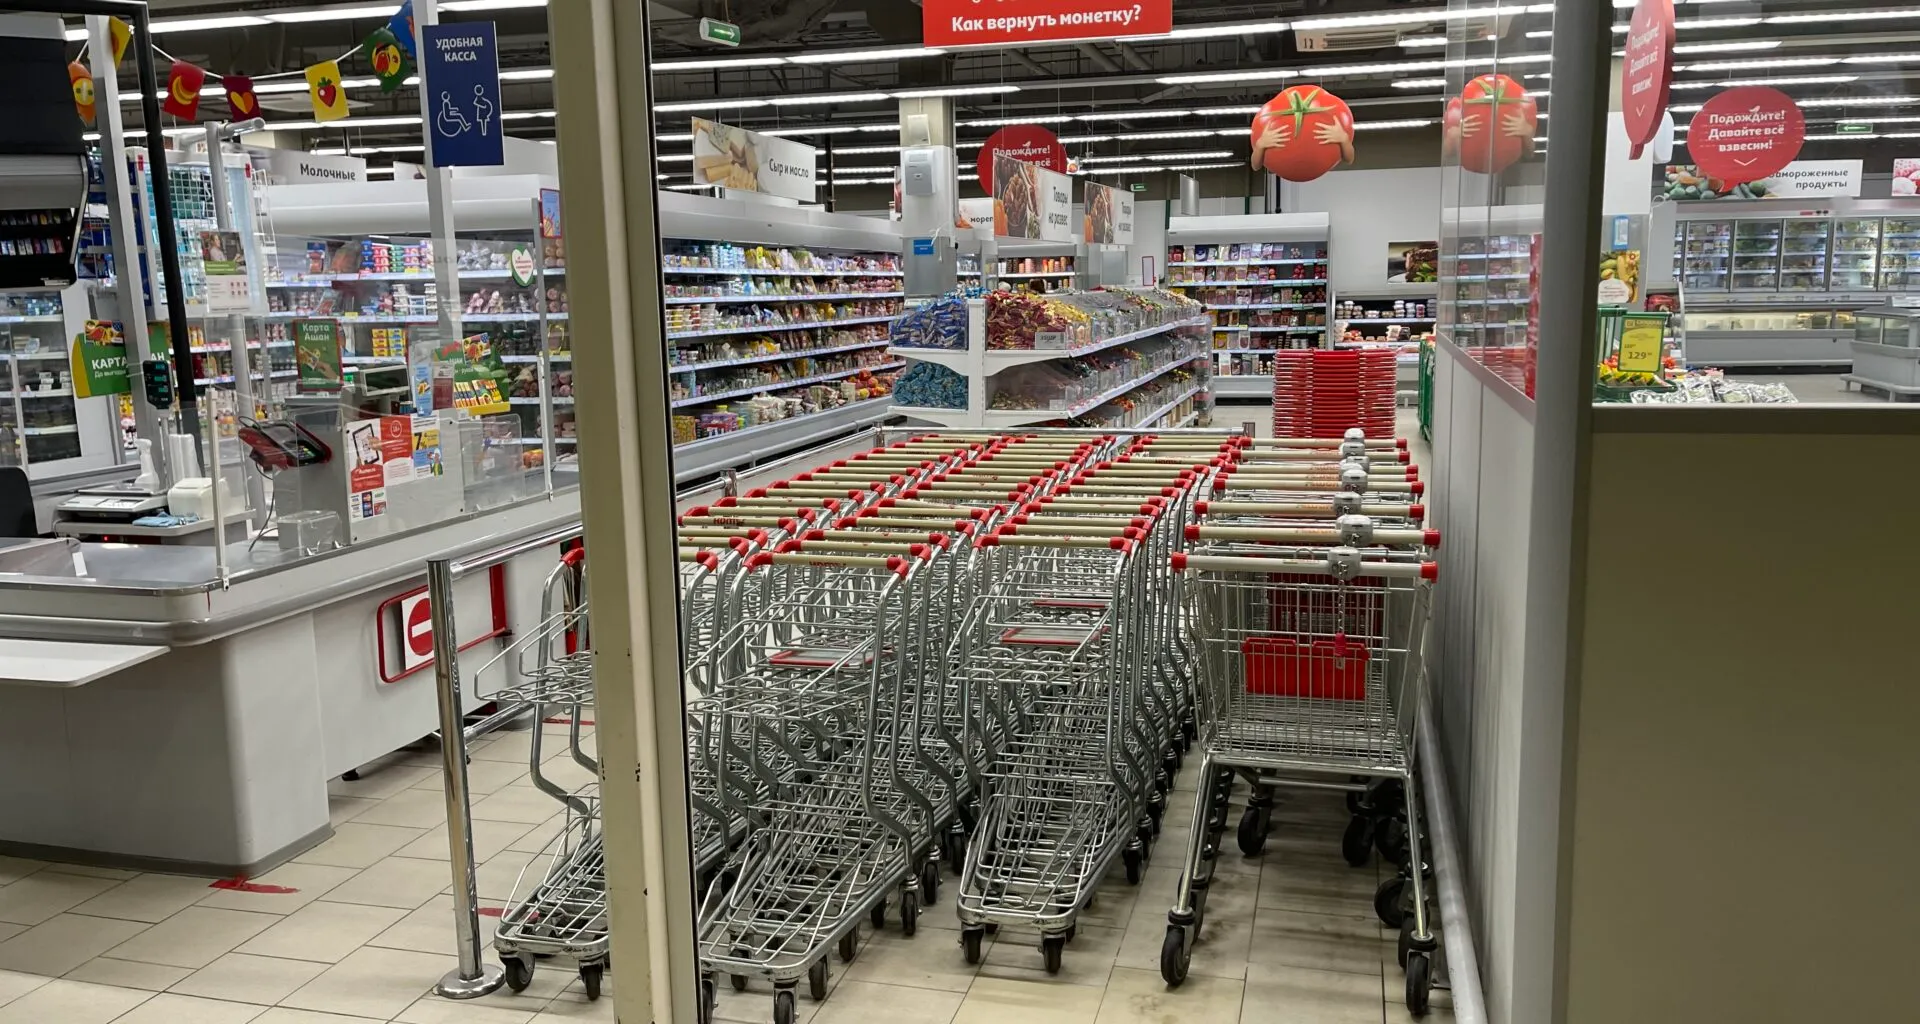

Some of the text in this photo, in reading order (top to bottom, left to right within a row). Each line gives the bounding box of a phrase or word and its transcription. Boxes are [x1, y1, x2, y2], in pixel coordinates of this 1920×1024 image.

[952, 4, 1142, 33] Как вернуть монетку?
[435, 36, 483, 51] УДОБНАЯ
[444, 51, 477, 62] КАССА
[1709, 109, 1785, 125] Подождите!
[1708, 124, 1785, 141] Давайте всё
[1718, 139, 1773, 152] взвесим!
[300, 163, 356, 180] Молочные
[769, 157, 783, 177] Сыр
[790, 165, 809, 178] масло
[1795, 181, 1847, 190] продукты
[302, 323, 330, 333] Карта
[304, 332, 330, 341] Ашан
